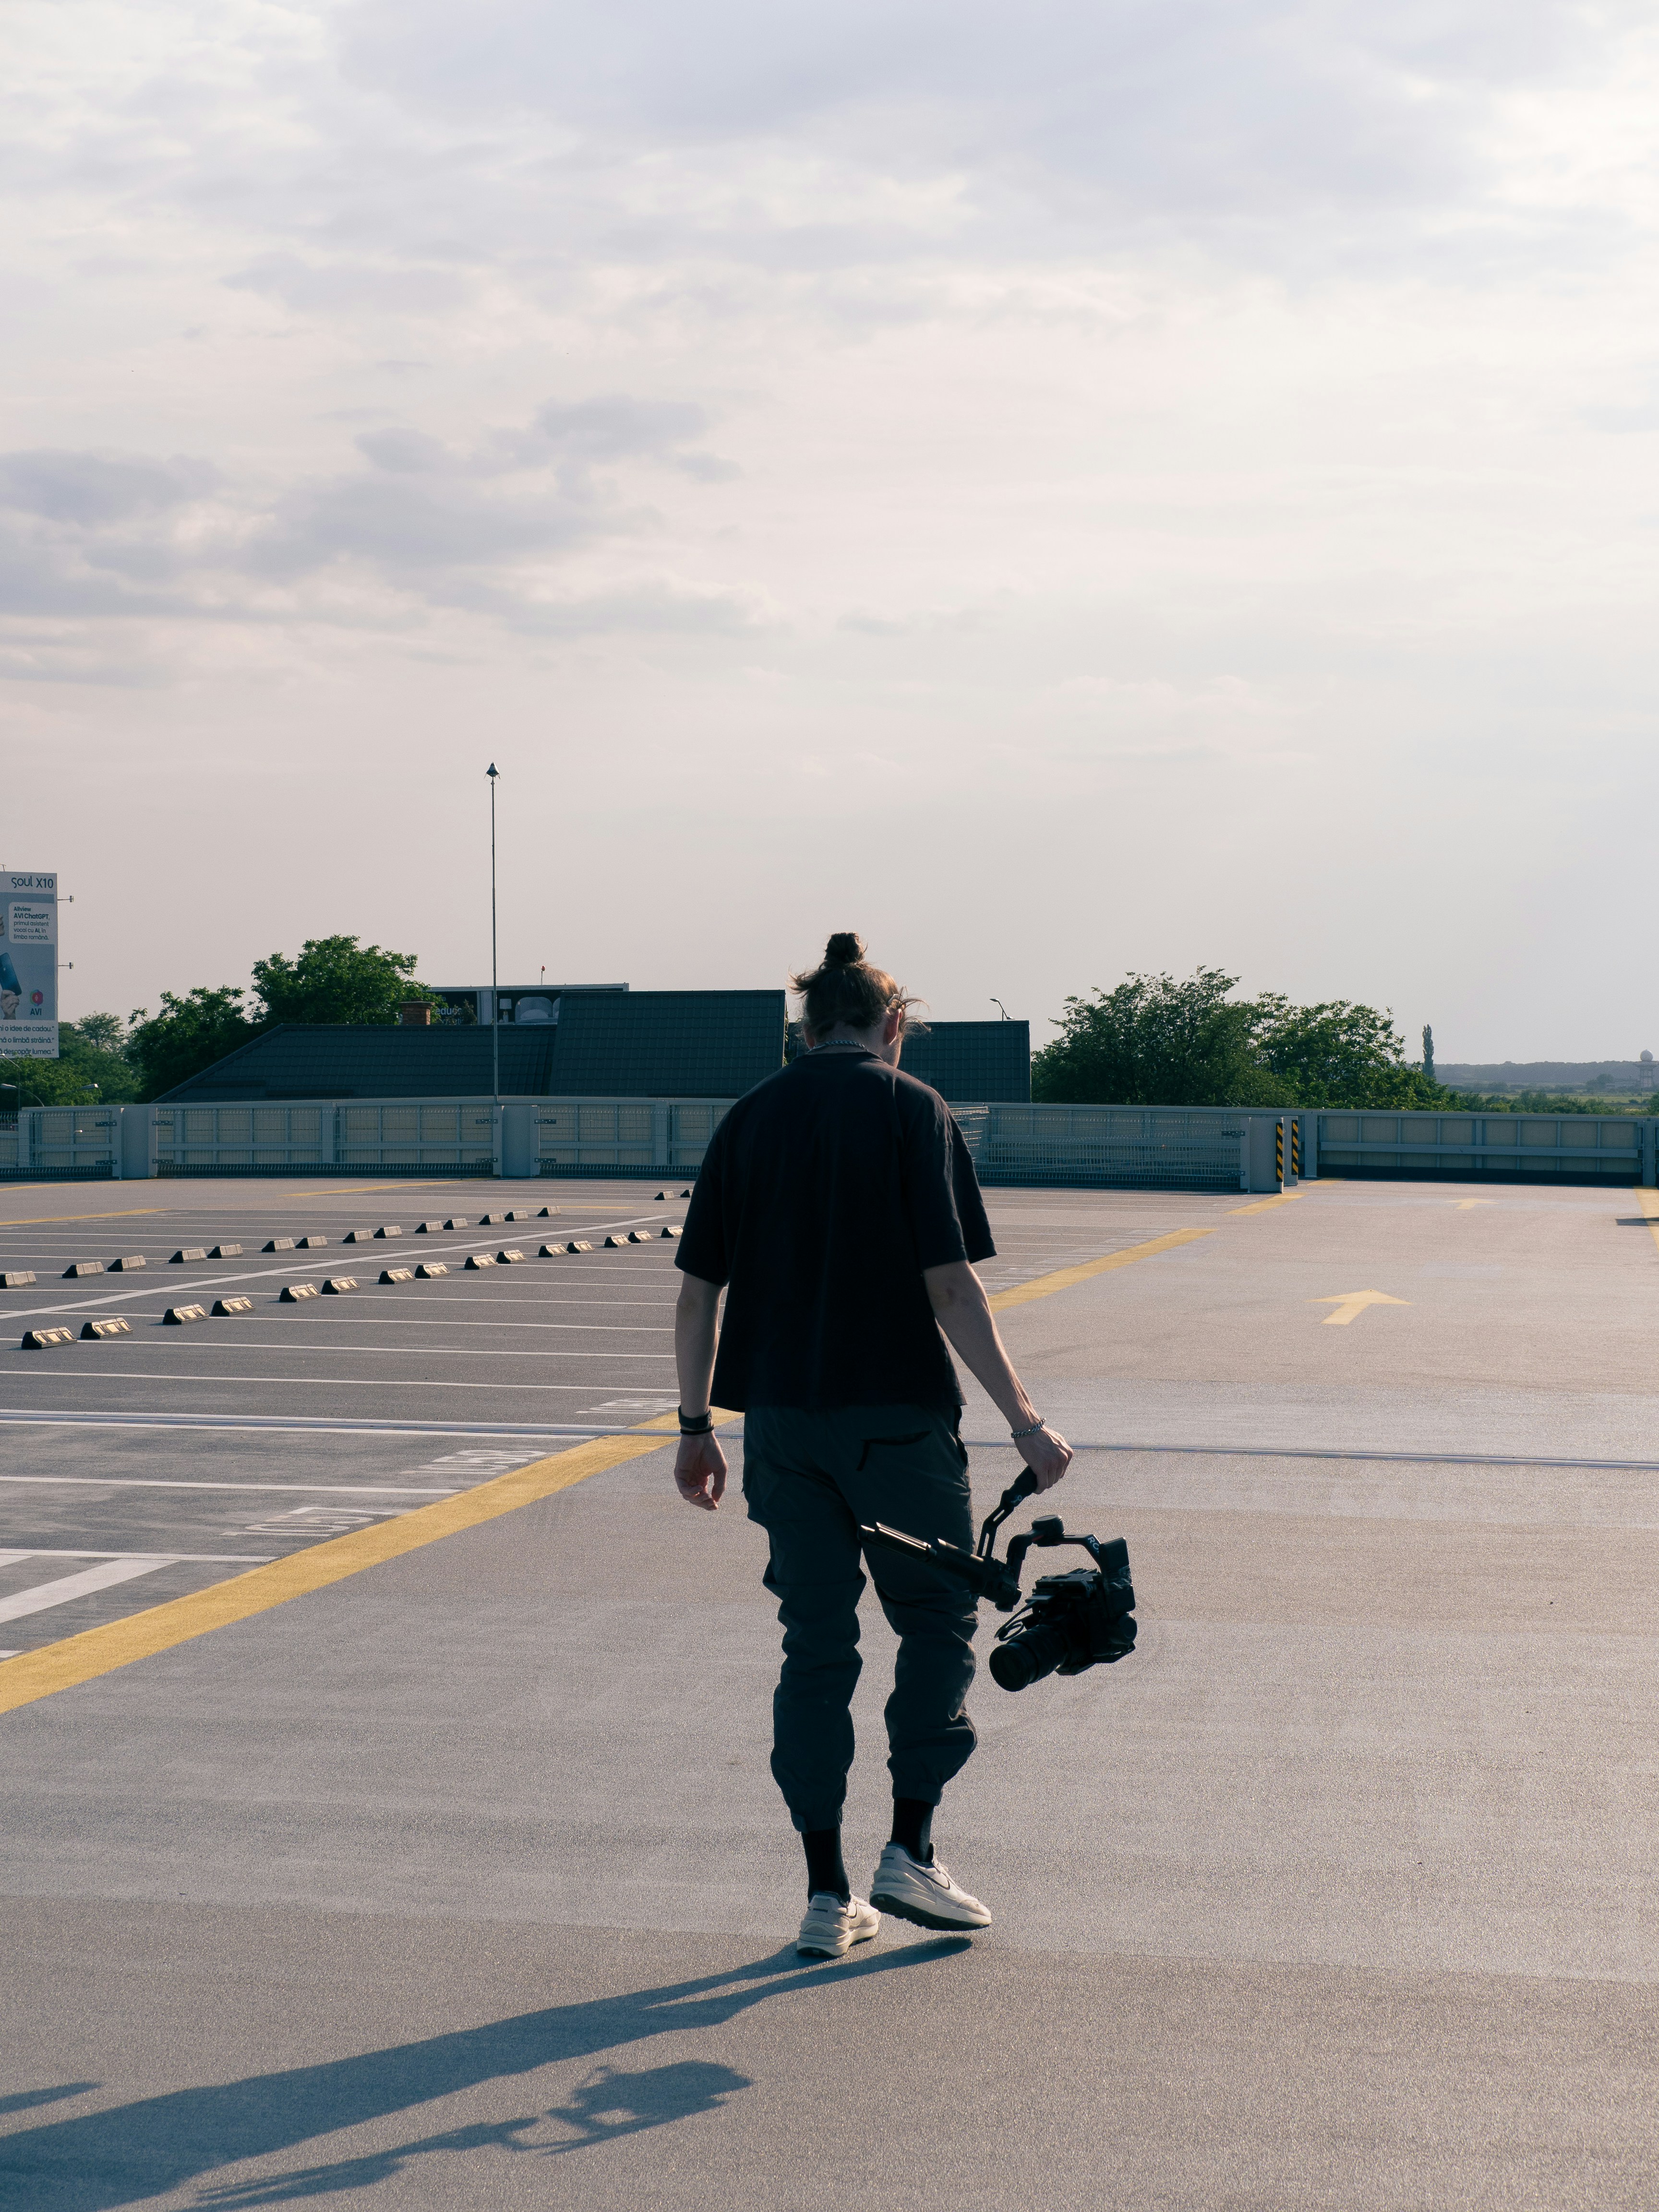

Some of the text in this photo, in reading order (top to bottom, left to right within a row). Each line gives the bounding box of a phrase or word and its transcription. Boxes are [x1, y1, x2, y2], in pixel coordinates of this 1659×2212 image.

[36, 878, 54, 889] X10
[399, 1449, 547, 1474] 1058
[218, 1506, 394, 1537] 1057
